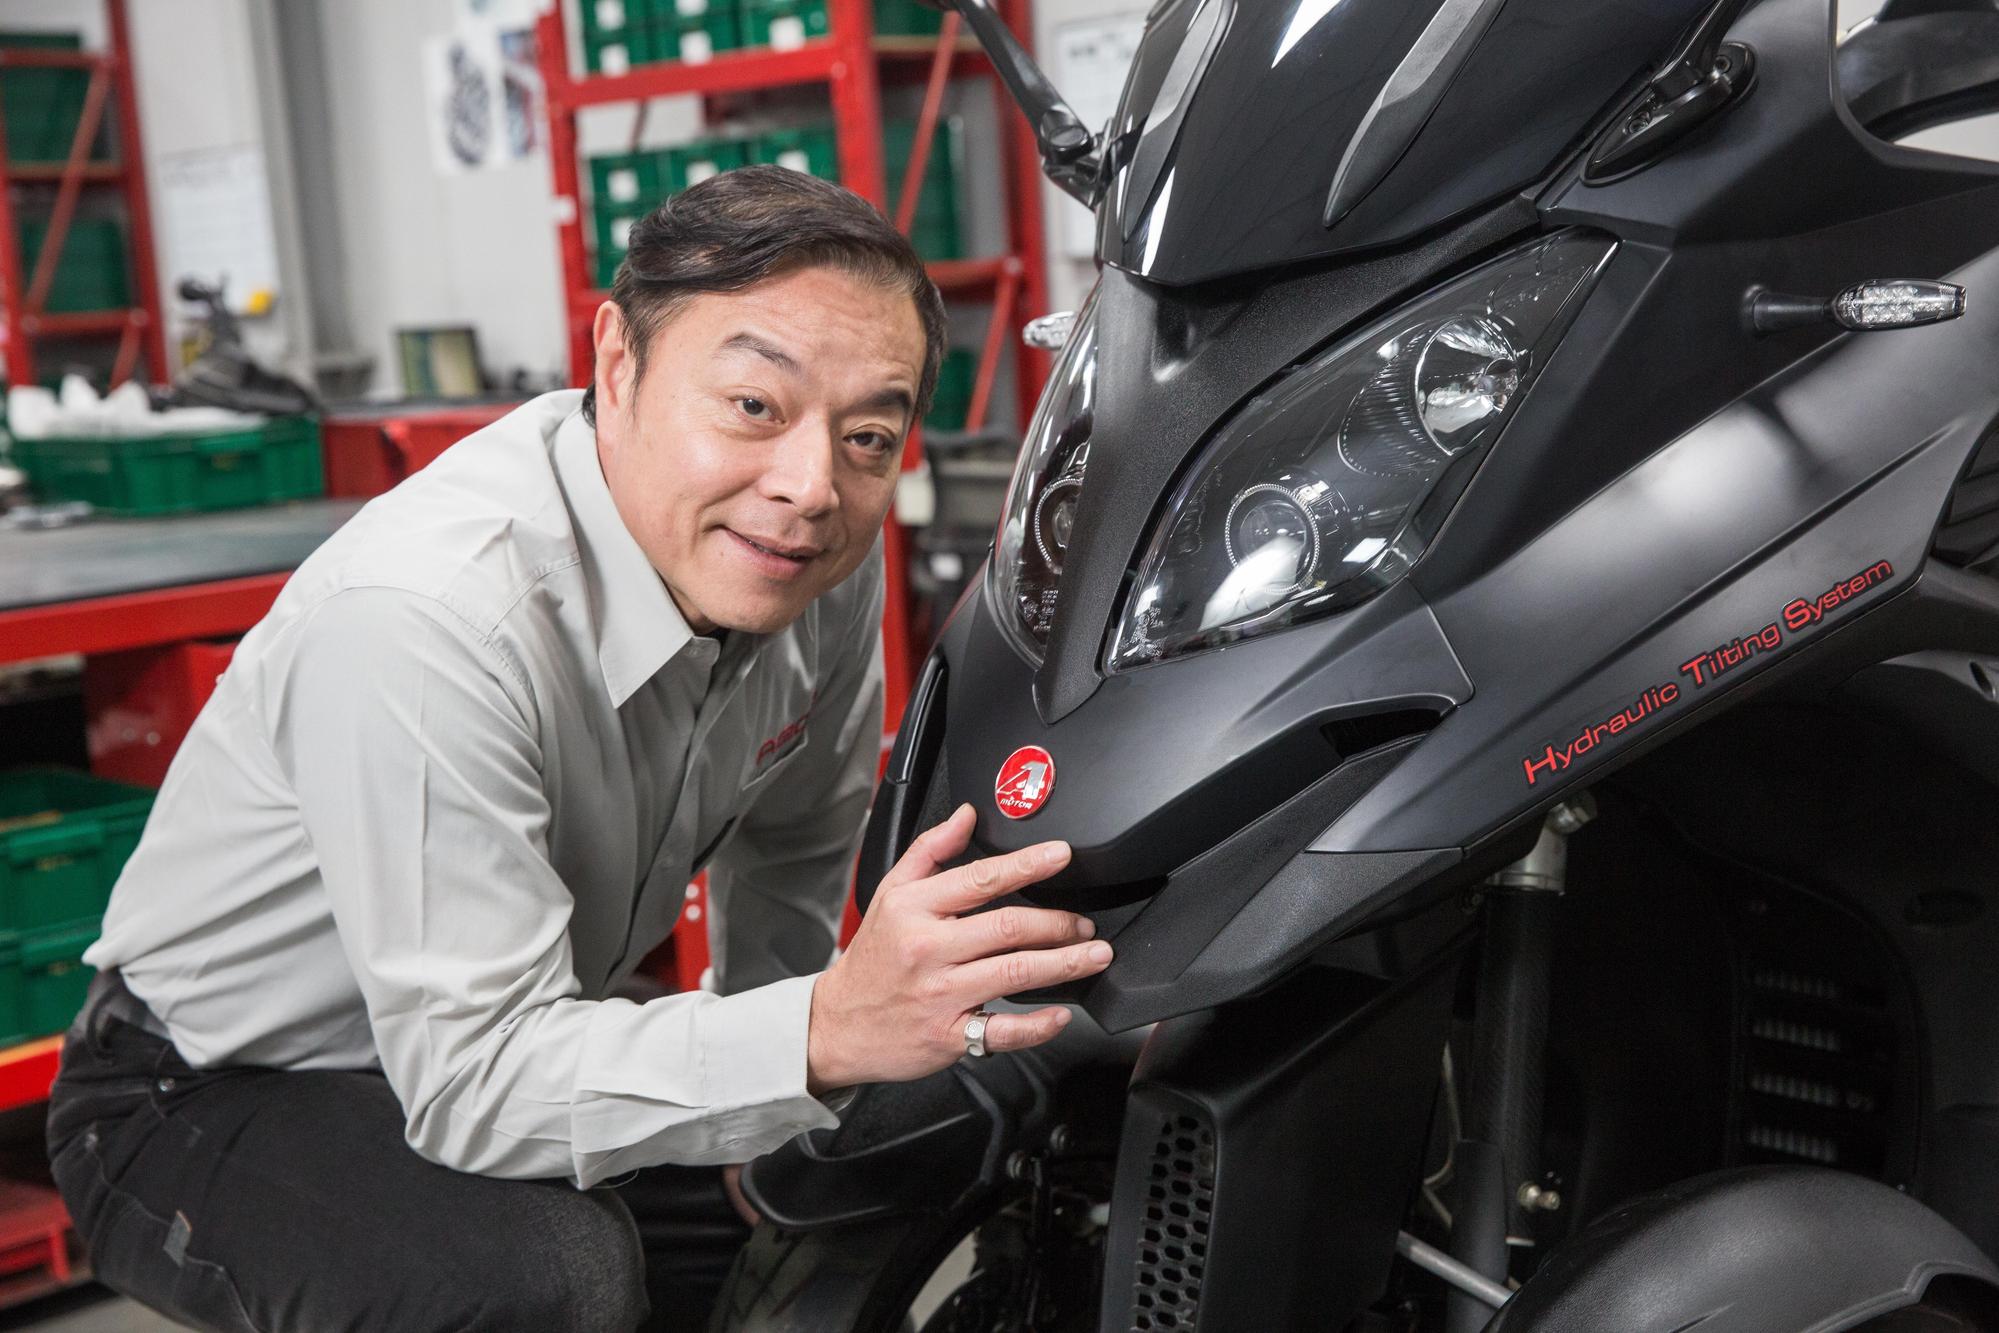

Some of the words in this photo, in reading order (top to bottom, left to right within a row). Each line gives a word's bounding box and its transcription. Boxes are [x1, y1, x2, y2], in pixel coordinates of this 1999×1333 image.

[1523, 682, 1679, 785] Hydraulic
[1681, 625, 1781, 686] Tilting
[1782, 561, 1893, 631] System
